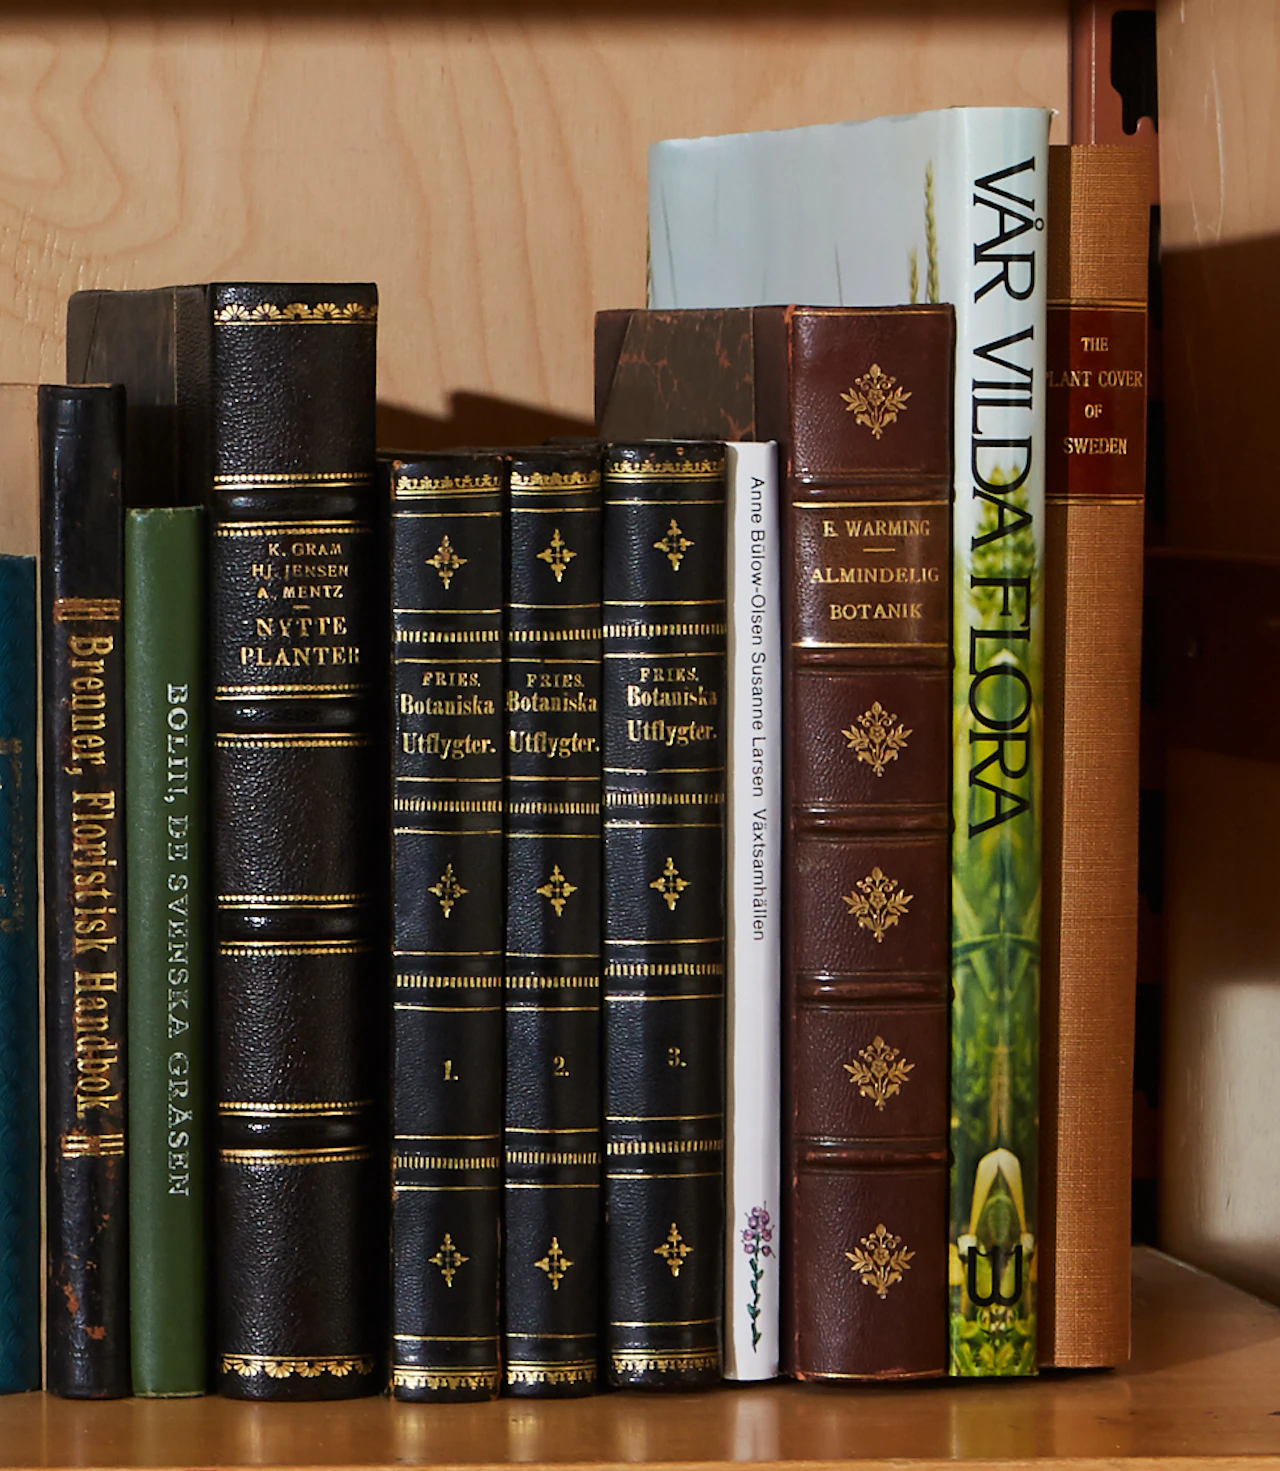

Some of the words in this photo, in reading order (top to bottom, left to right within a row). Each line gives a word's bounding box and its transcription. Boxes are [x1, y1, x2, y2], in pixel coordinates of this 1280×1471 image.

[973, 156, 1044, 303] VÅR
[1080, 336, 1109, 352] THE
[1098, 370, 1143, 387] COVER
[1084, 403, 1103, 419] OF
[971, 325, 1034, 551] VILDA
[1063, 437, 1128, 455] SWEDEN
[751, 476, 765, 524] Anne
[844, 520, 930, 537] WARMING
[268, 542, 287, 557] K.
[291, 541, 343, 557] GRAM
[284, 564, 349, 580] JENSEN
[810, 567, 939, 583] ALMINDELIG
[282, 585, 344, 599] MENTZ
[751, 529, 766, 646] Bülow-Olsen
[829, 603, 924, 620] BOTANIK
[255, 615, 348, 638] NYTTE
[240, 646, 360, 667] PLANTER
[506, 689, 598, 713] Botaniska
[626, 684, 718, 707] Botaniska
[751, 651, 766, 731] Susanne
[64, 634, 115, 777] Brenner,
[400, 692, 495, 716] Botaniska
[968, 575, 1032, 840] FLORA
[163, 683, 189, 804] BOLIN,
[508, 729, 600, 760] Utflygter.
[626, 719, 718, 747] Utflygter.
[402, 731, 497, 760] Utflygter.
[752, 737, 765, 797] Larsen
[167, 816, 189, 863] DE
[72, 790, 118, 956] Floristisk
[752, 808, 769, 942] Växtsamhällen
[167, 873, 190, 1039] SVENSKA
[553, 1055, 570, 1077] 2.
[667, 1046, 688, 1068] 3.
[442, 1059, 459, 1081] 1.
[167, 1051, 193, 1196] GRÄSEN
